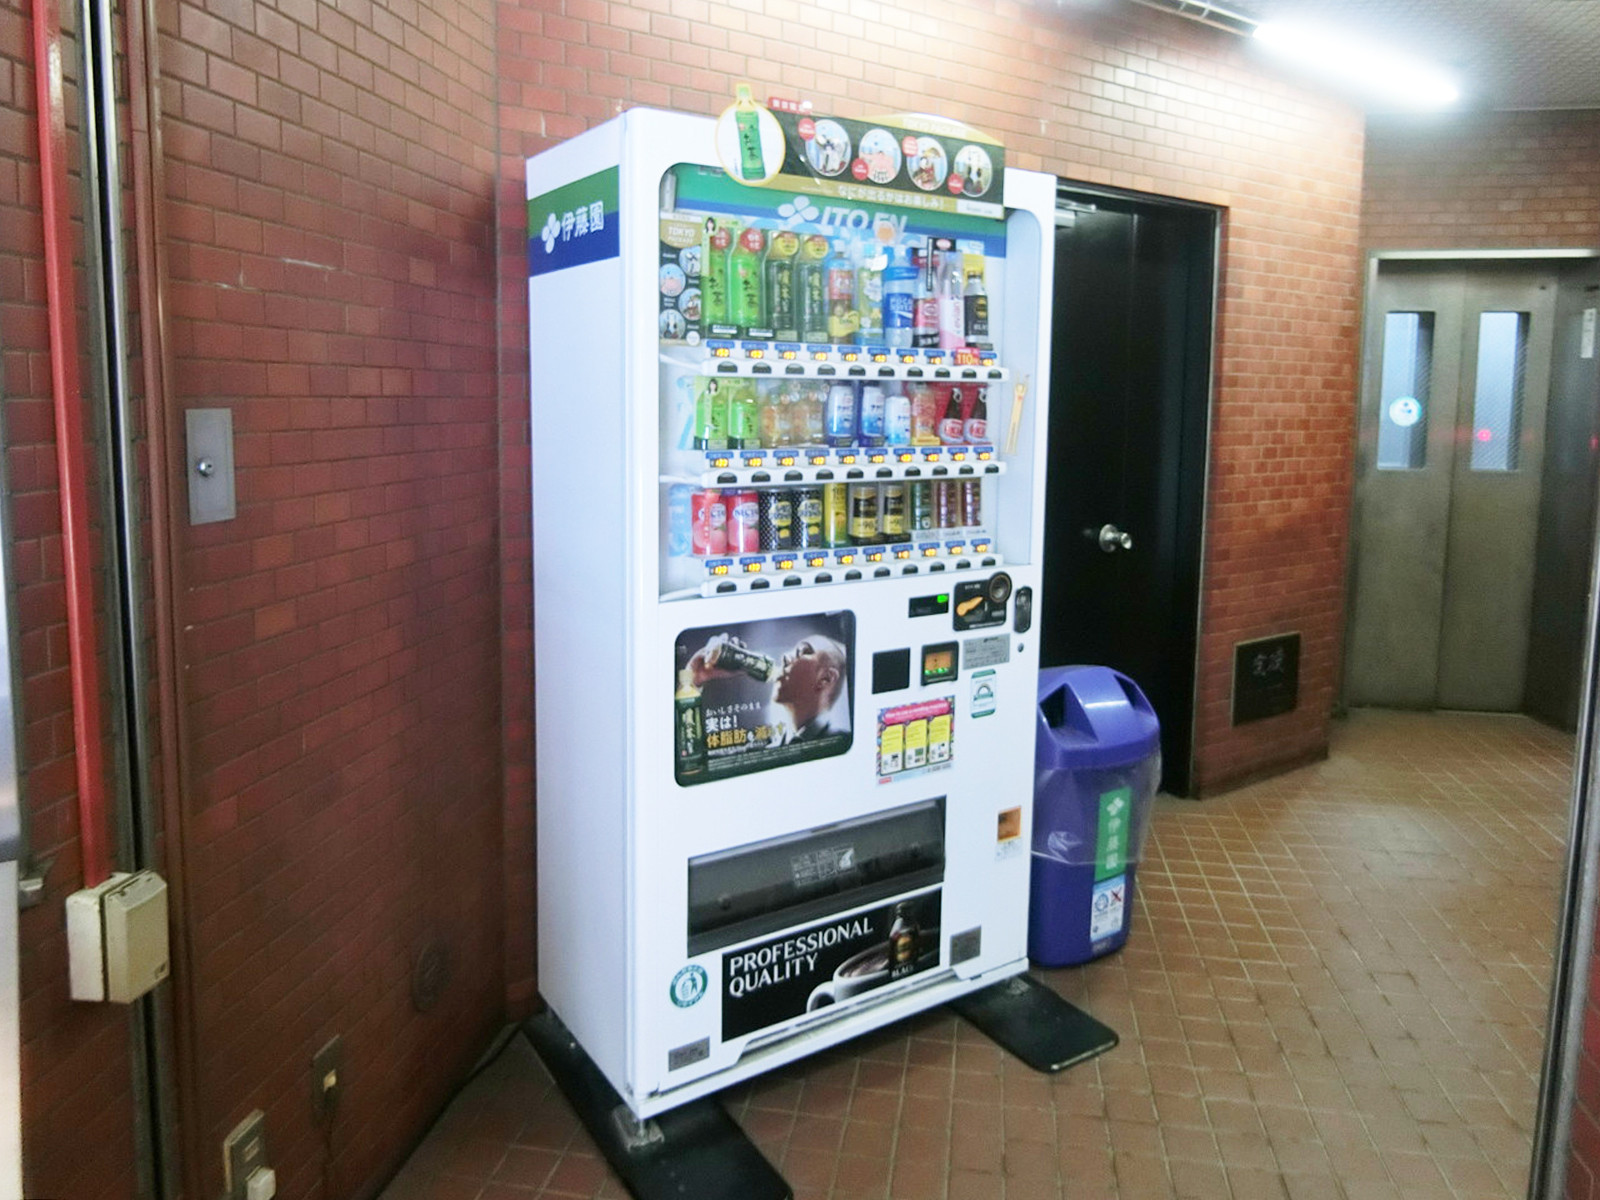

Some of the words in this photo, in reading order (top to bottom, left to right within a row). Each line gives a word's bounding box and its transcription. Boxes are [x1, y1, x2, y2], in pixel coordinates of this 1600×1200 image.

[561, 200, 604, 242] 伊藤園
[820, 206, 869, 230] ITO
[728, 917, 874, 978] PROFESSIONAL
[728, 952, 819, 998] QUALITY
